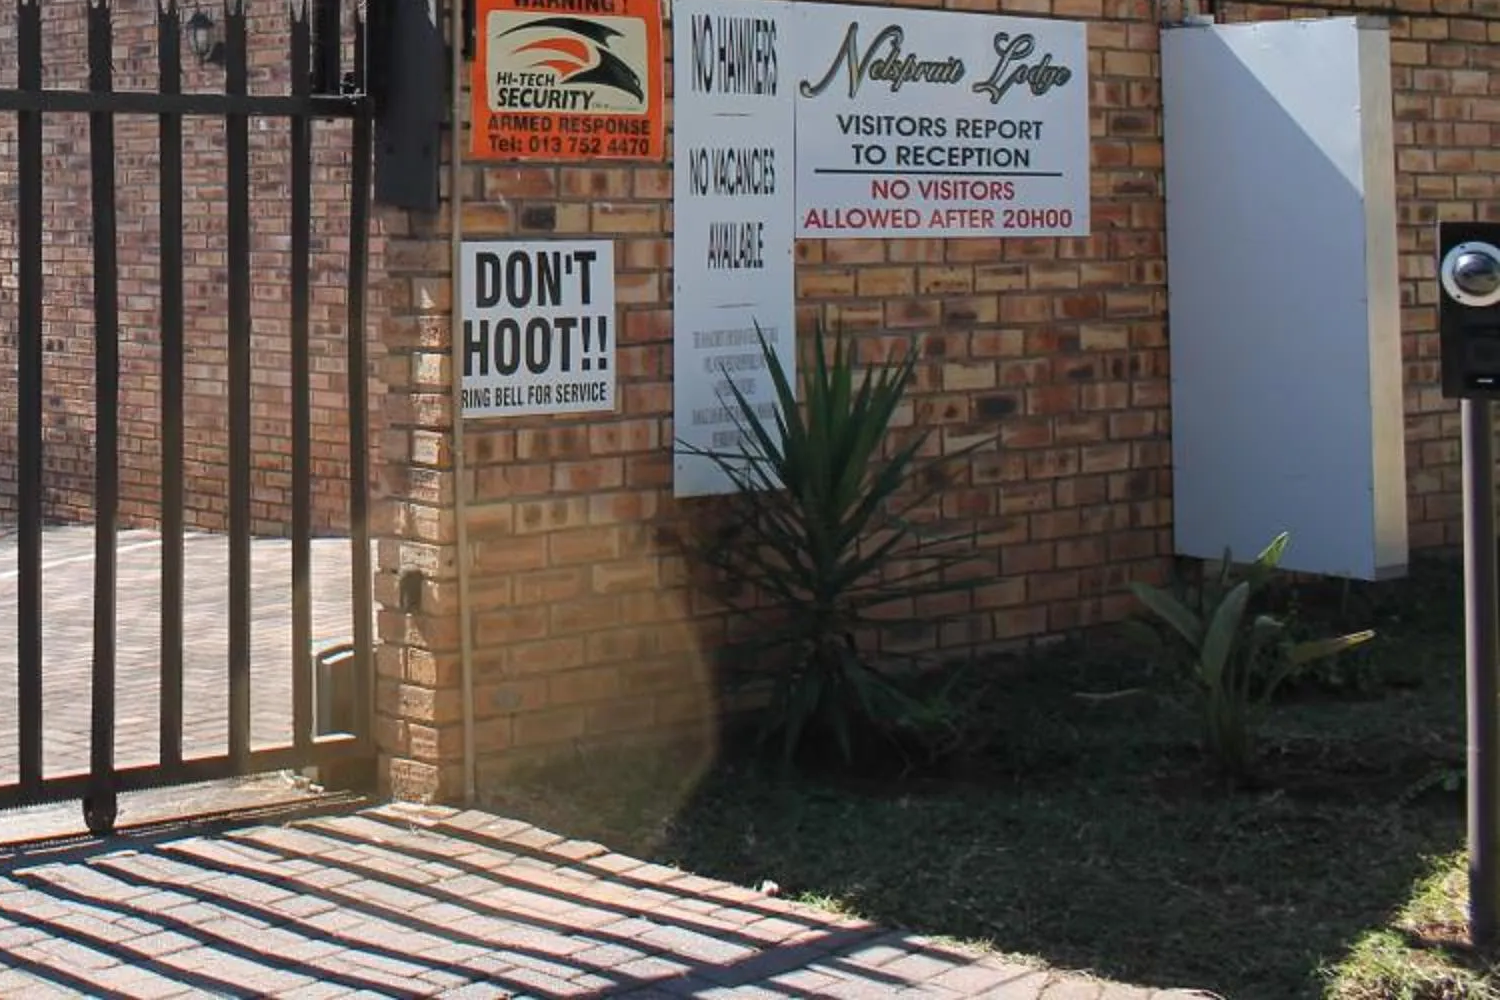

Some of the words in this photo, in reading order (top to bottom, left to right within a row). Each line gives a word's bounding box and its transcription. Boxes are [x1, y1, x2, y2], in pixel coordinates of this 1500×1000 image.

[691, 13, 715, 94] NO
[717, 16, 778, 96] HAWKERS
[800, 20, 965, 99] Nelspruit
[972, 31, 1072, 104] Lodge
[496, 71, 555, 87] HI-TECH
[497, 87, 594, 110] SECURITY
[487, 115, 551, 135] ARMED
[559, 116, 651, 135] RESPONSE
[836, 114, 947, 138] VISITORS
[955, 119, 1044, 140] REPORT
[487, 134, 521, 153] Tel:
[528, 135, 561, 153] 013
[569, 136, 600, 154] 752
[607, 136, 649, 156] 4470
[852, 143, 886, 166] TO
[896, 145, 1030, 168] RECEPTION
[690, 148, 709, 196] NO
[712, 148, 776, 196] VACANCIES
[871, 179, 910, 201] NO
[918, 180, 1016, 202] VISITORS
[803, 207, 922, 230] ALLOWED
[928, 208, 994, 229] AFTER
[1003, 208, 1073, 229] 20H00
[707, 222, 765, 270] AVAILABLE
[475, 250, 597, 309] DON'T
[463, 315, 607, 377] HOOT!!
[462, 387, 492, 409] RING
[495, 386, 524, 407] BELL
[527, 384, 551, 405] FOR
[555, 381, 608, 405] SERVICE
